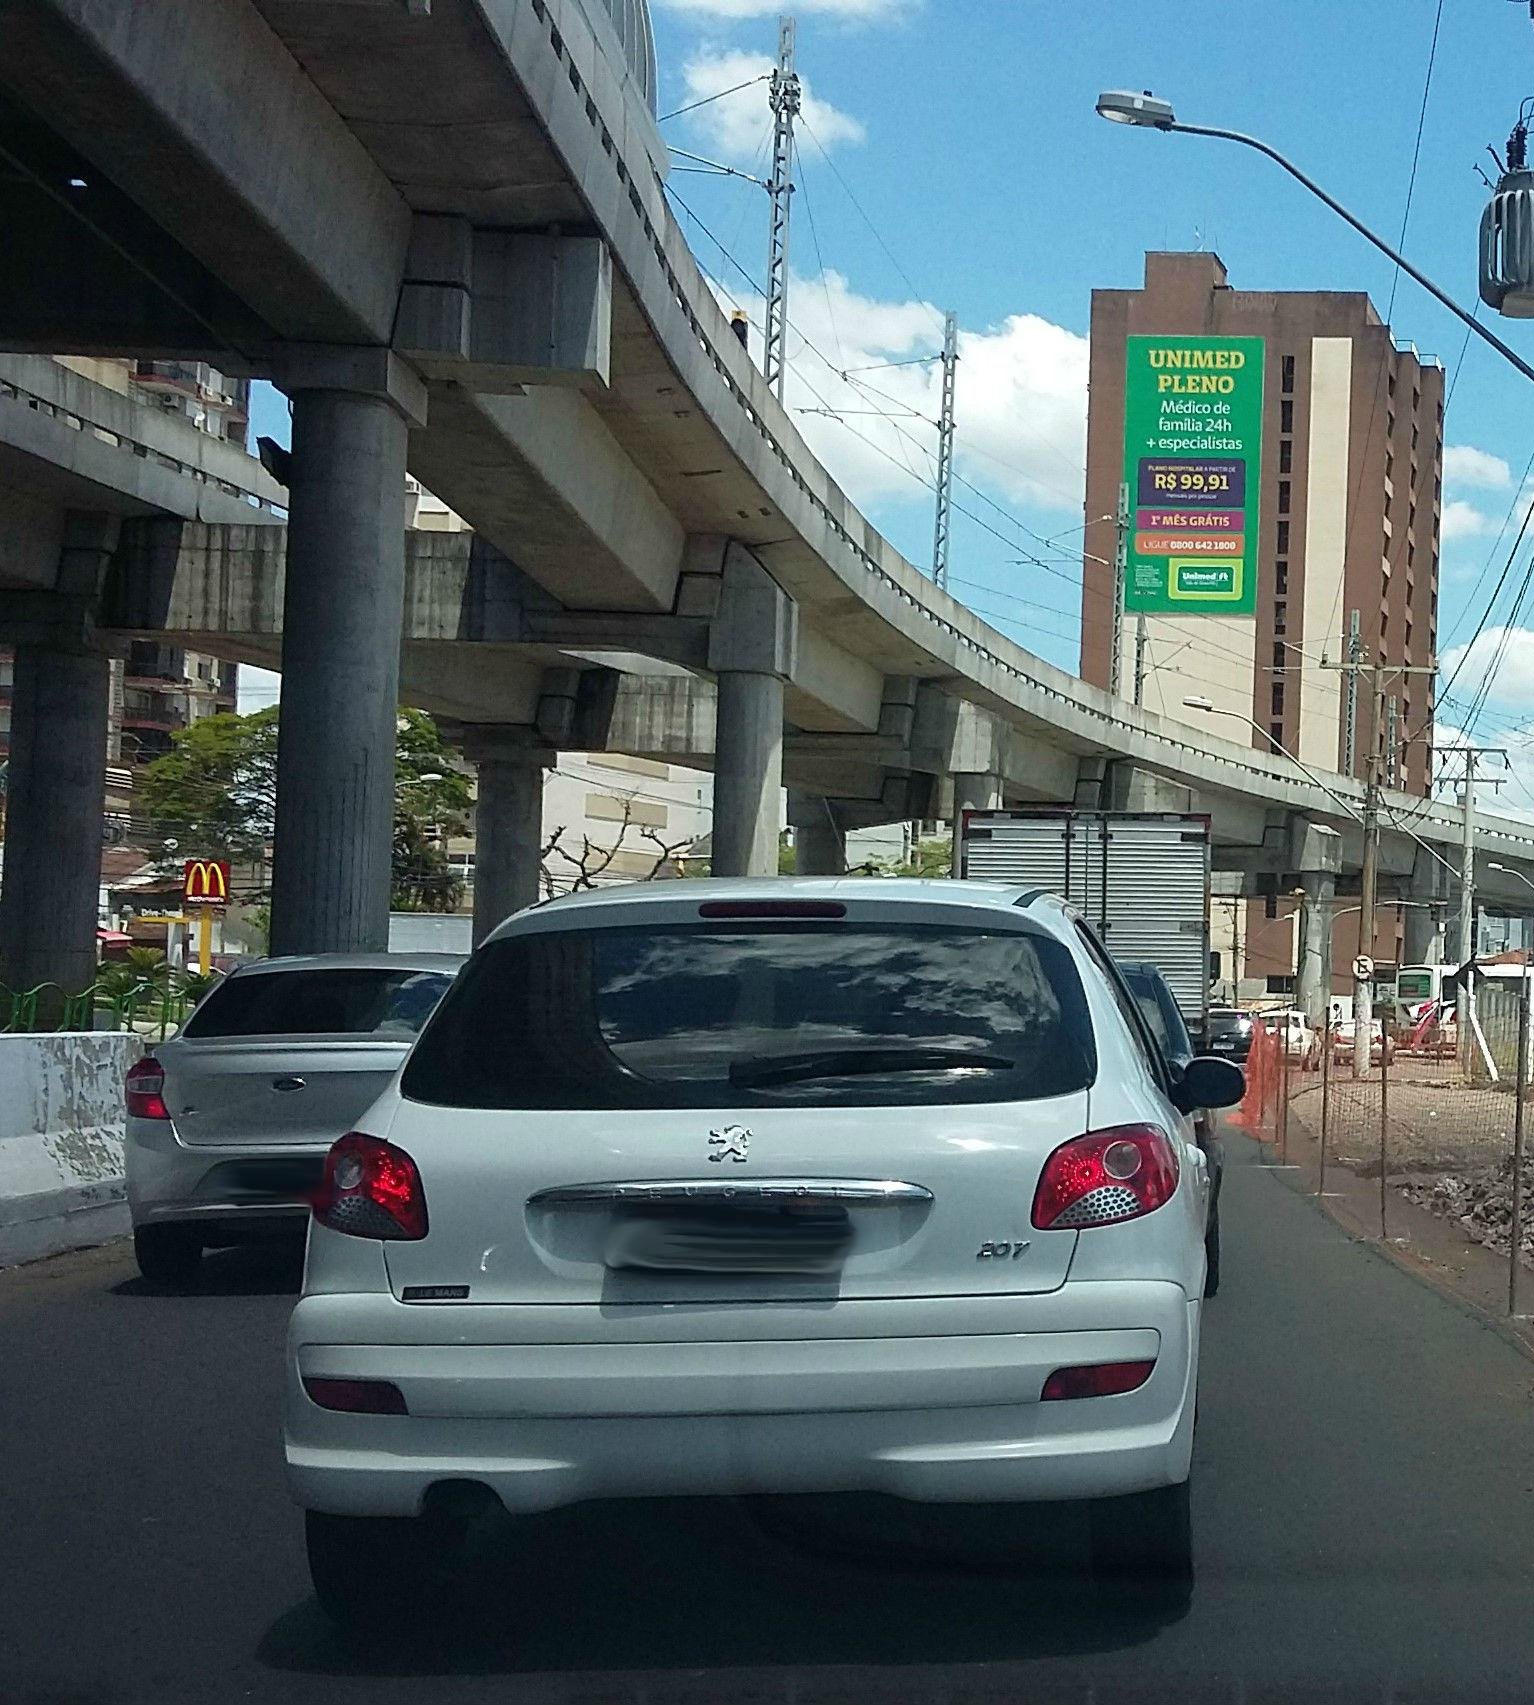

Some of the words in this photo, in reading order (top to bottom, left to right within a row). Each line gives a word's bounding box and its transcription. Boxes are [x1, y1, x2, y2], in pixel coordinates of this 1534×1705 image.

[1149, 350, 1245, 369] UNIMED
[1158, 375, 1235, 394] PLENO
[1160, 400, 1212, 415] Médico
[1213, 401, 1231, 415] de
[1158, 417, 1203, 432] família
[1205, 418, 1232, 432] 24h
[1158, 436, 1243, 452] especialistas
[1155, 473, 1177, 491] R$
[1180, 474, 1230, 493] 99,91
[1162, 513, 1189, 527] MÊS
[1190, 513, 1230, 527] GRÁTIS
[1144, 541, 1169, 549] LIGUE
[1170, 541, 1194, 550] 0800
[1195, 541, 1213, 550] 642
[1182, 572, 1217, 581] Unimed
[613, 1186, 845, 1200] PEUGEOT
[976, 1240, 1031, 1260] 207
